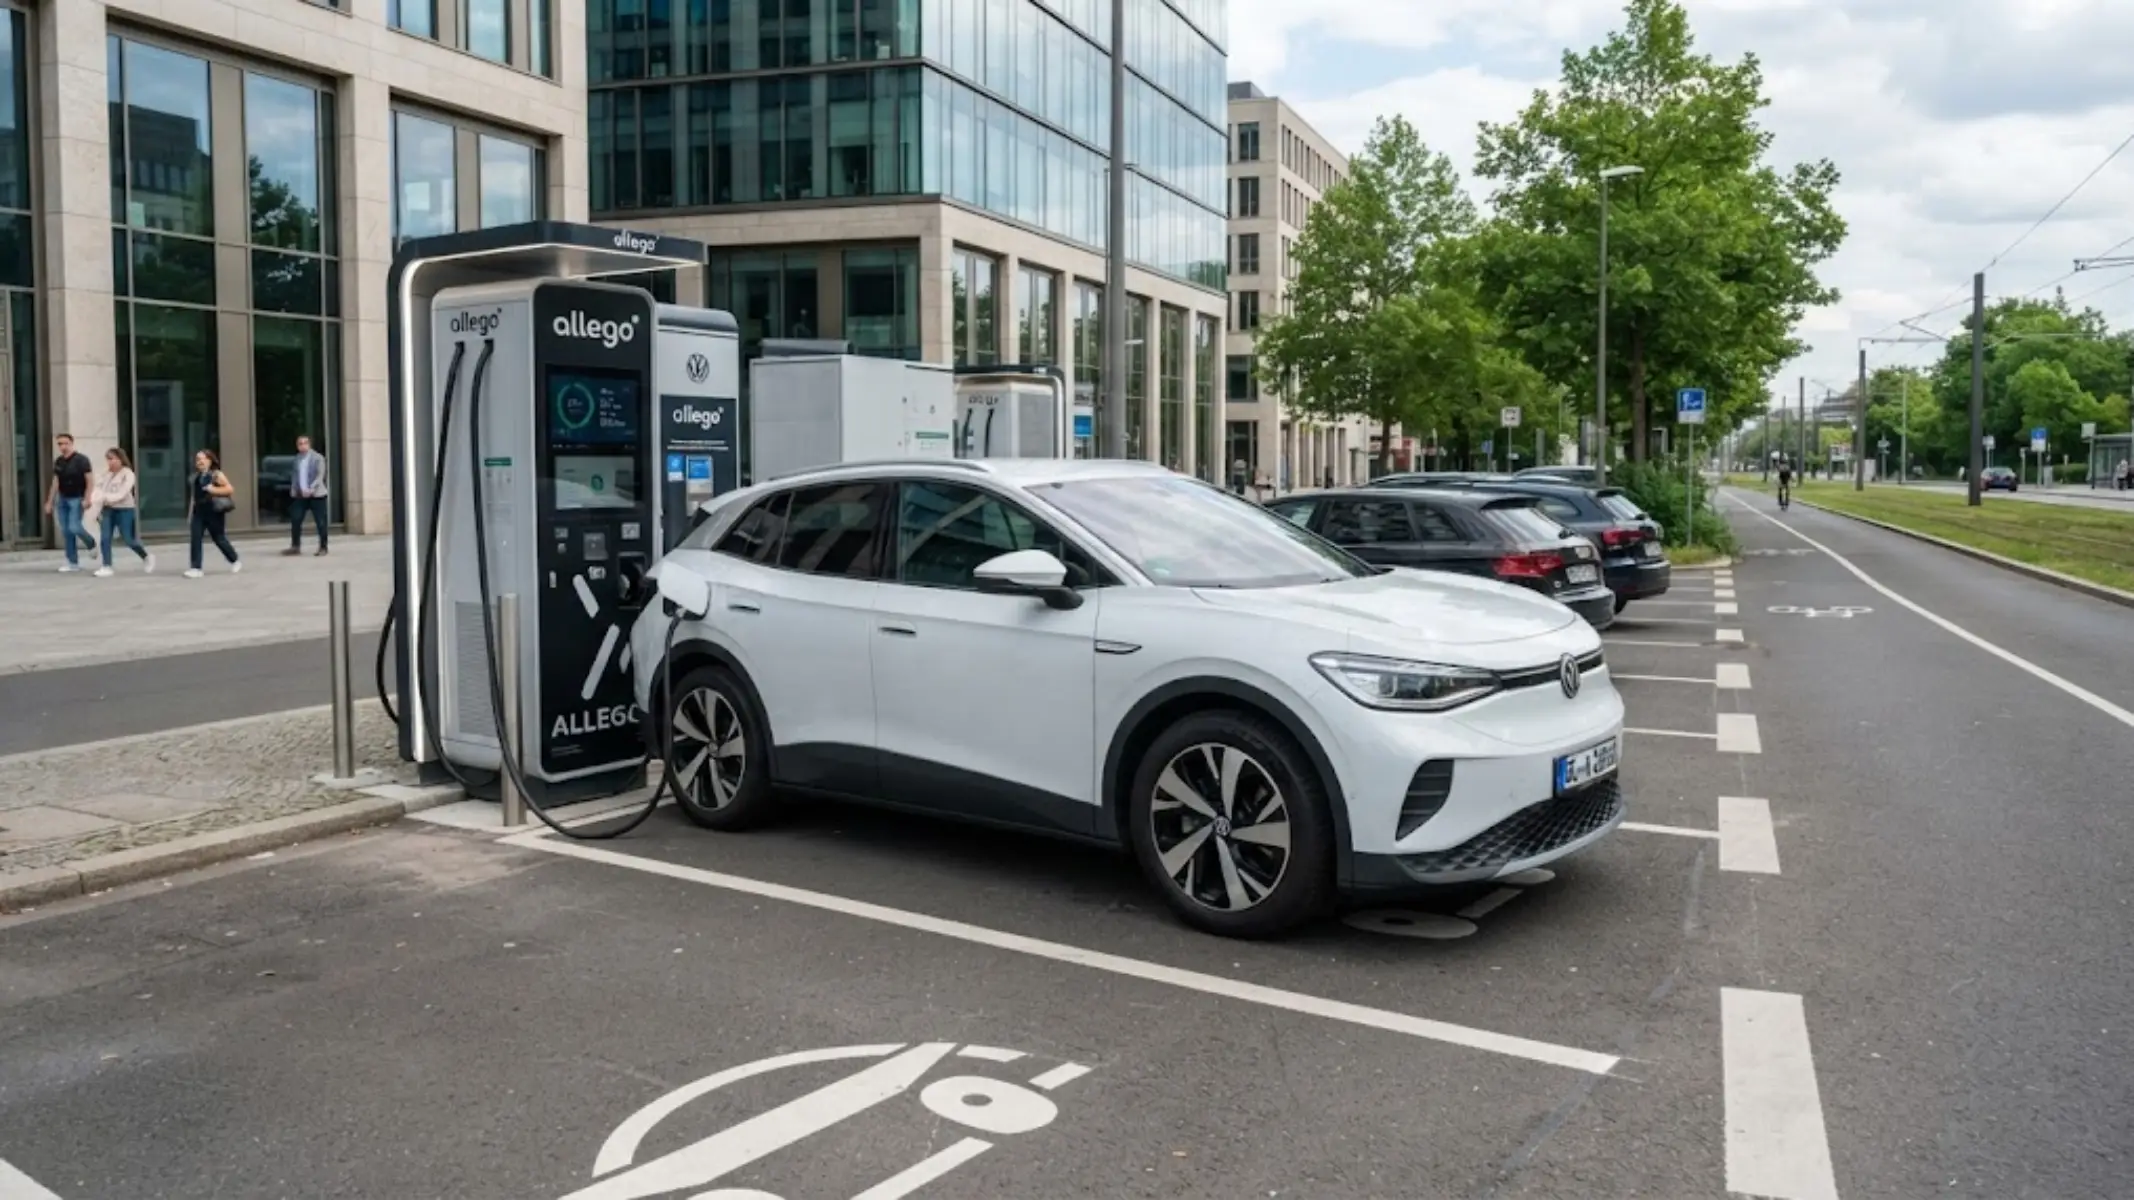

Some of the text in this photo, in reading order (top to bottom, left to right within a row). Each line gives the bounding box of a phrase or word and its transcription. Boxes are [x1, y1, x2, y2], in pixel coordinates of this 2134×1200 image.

[613, 229, 656, 254] allego
[450, 311, 500, 336] allego
[552, 310, 635, 348] allego
